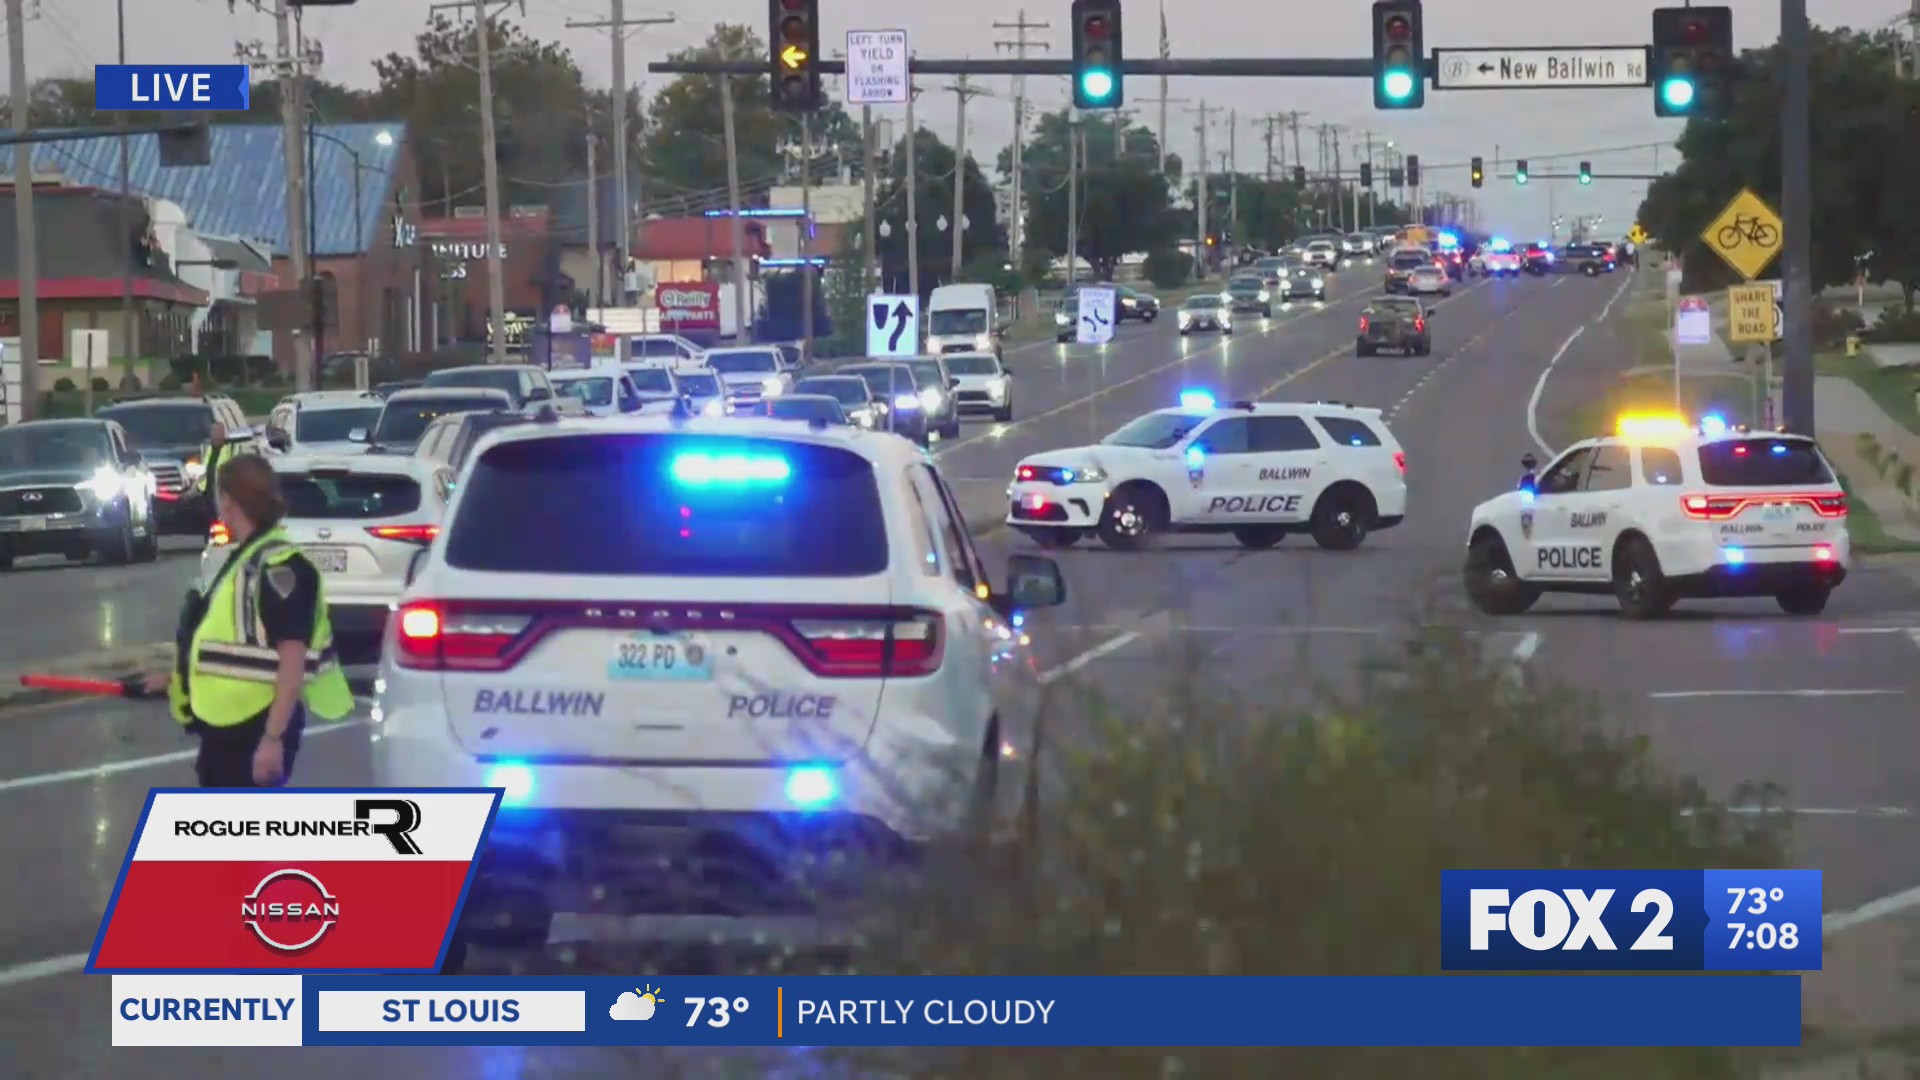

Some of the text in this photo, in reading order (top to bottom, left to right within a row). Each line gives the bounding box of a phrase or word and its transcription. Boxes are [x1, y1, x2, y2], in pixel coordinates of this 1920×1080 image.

[850, 34, 902, 45] LEFT TURN
[861, 47, 893, 60] YIELD
[1500, 57, 1537, 80] New
[1548, 55, 1615, 80] Ballwin
[1627, 65, 1642, 78] Rd
[854, 76, 899, 86] FLASHING
[862, 88, 892, 98] ARROW
[1734, 290, 1766, 303] SHARE
[1742, 307, 1760, 319] THE
[1738, 323, 1766, 335] ROAD
[1258, 466, 1311, 480] BALLWIN
[1208, 495, 1303, 513] POLICE
[1570, 511, 1607, 528] BALLWIN
[1538, 547, 1602, 569] POLICE
[618, 643, 675, 669] 322 PD
[474, 689, 837, 719] BALLWIN POLICE
